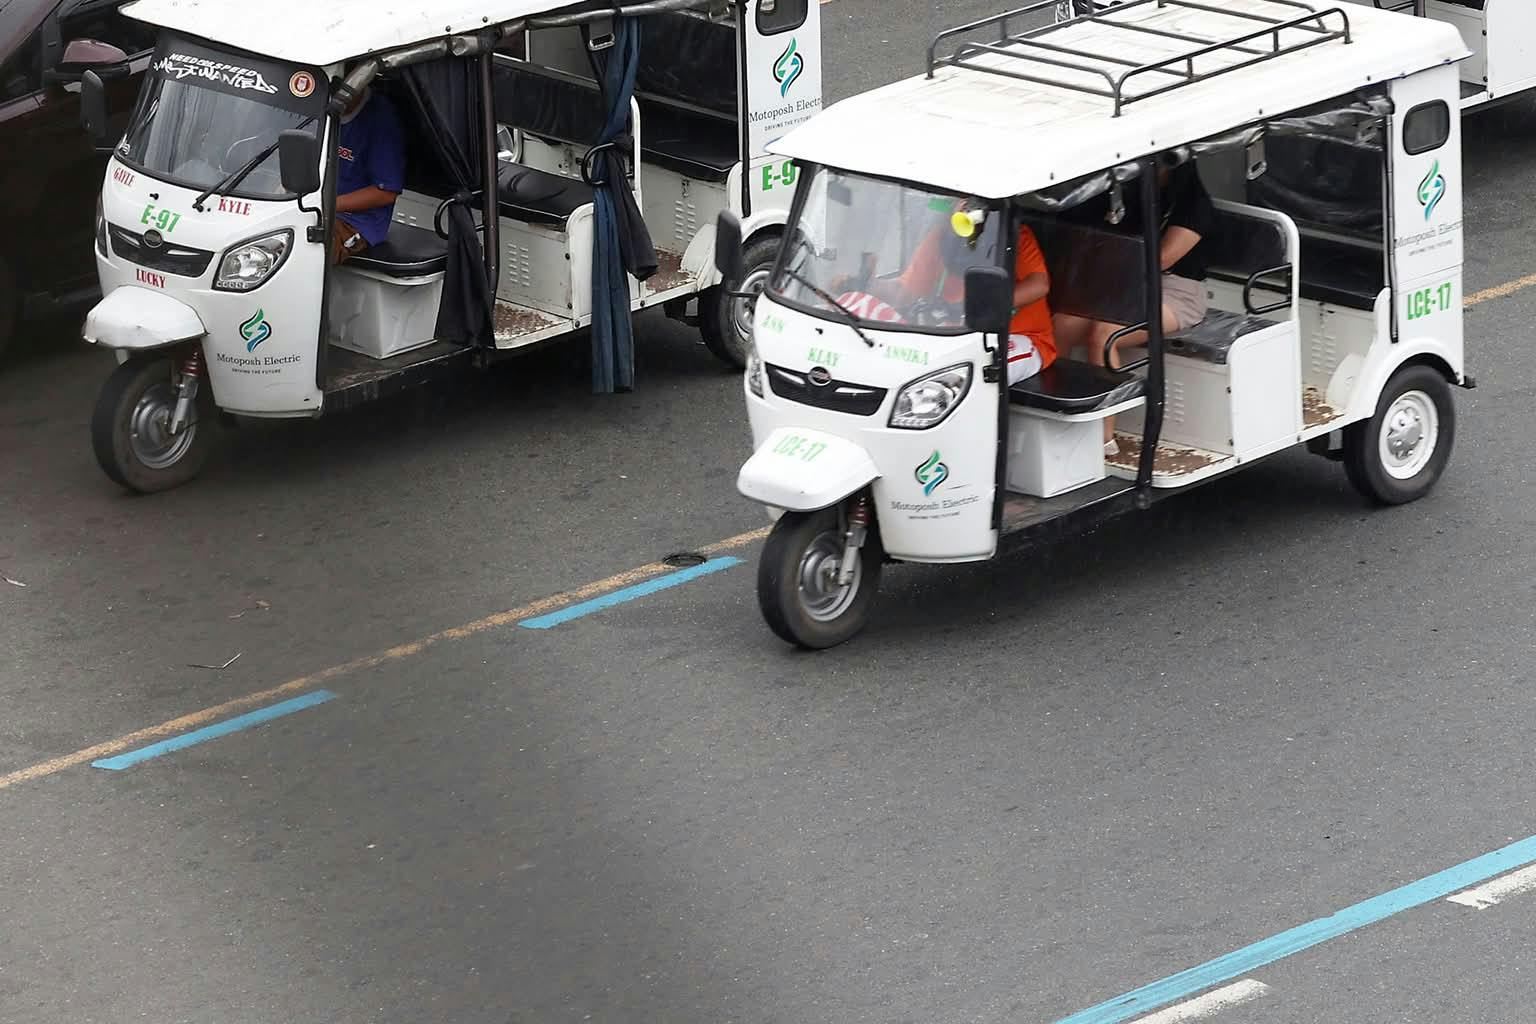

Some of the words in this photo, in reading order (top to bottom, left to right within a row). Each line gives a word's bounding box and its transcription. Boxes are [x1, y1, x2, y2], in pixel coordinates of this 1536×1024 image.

[169, 53, 198, 64] NEED
[213, 62, 258, 77] SPEED
[750, 104, 794, 123] Motoposh
[113, 167, 135, 187] GAYLE
[762, 160, 797, 191] E-9
[218, 198, 252, 216] KYLE
[141, 204, 181, 233] E-97
[136, 268, 166, 289] LUCKY
[1408, 282, 1452, 321] LCE-17
[216, 353, 261, 367] Motoposh
[264, 354, 301, 366] Electric
[807, 347, 841, 367] KLAY
[884, 345, 930, 366] ANNIKA
[772, 433, 828, 462] LCE-17
